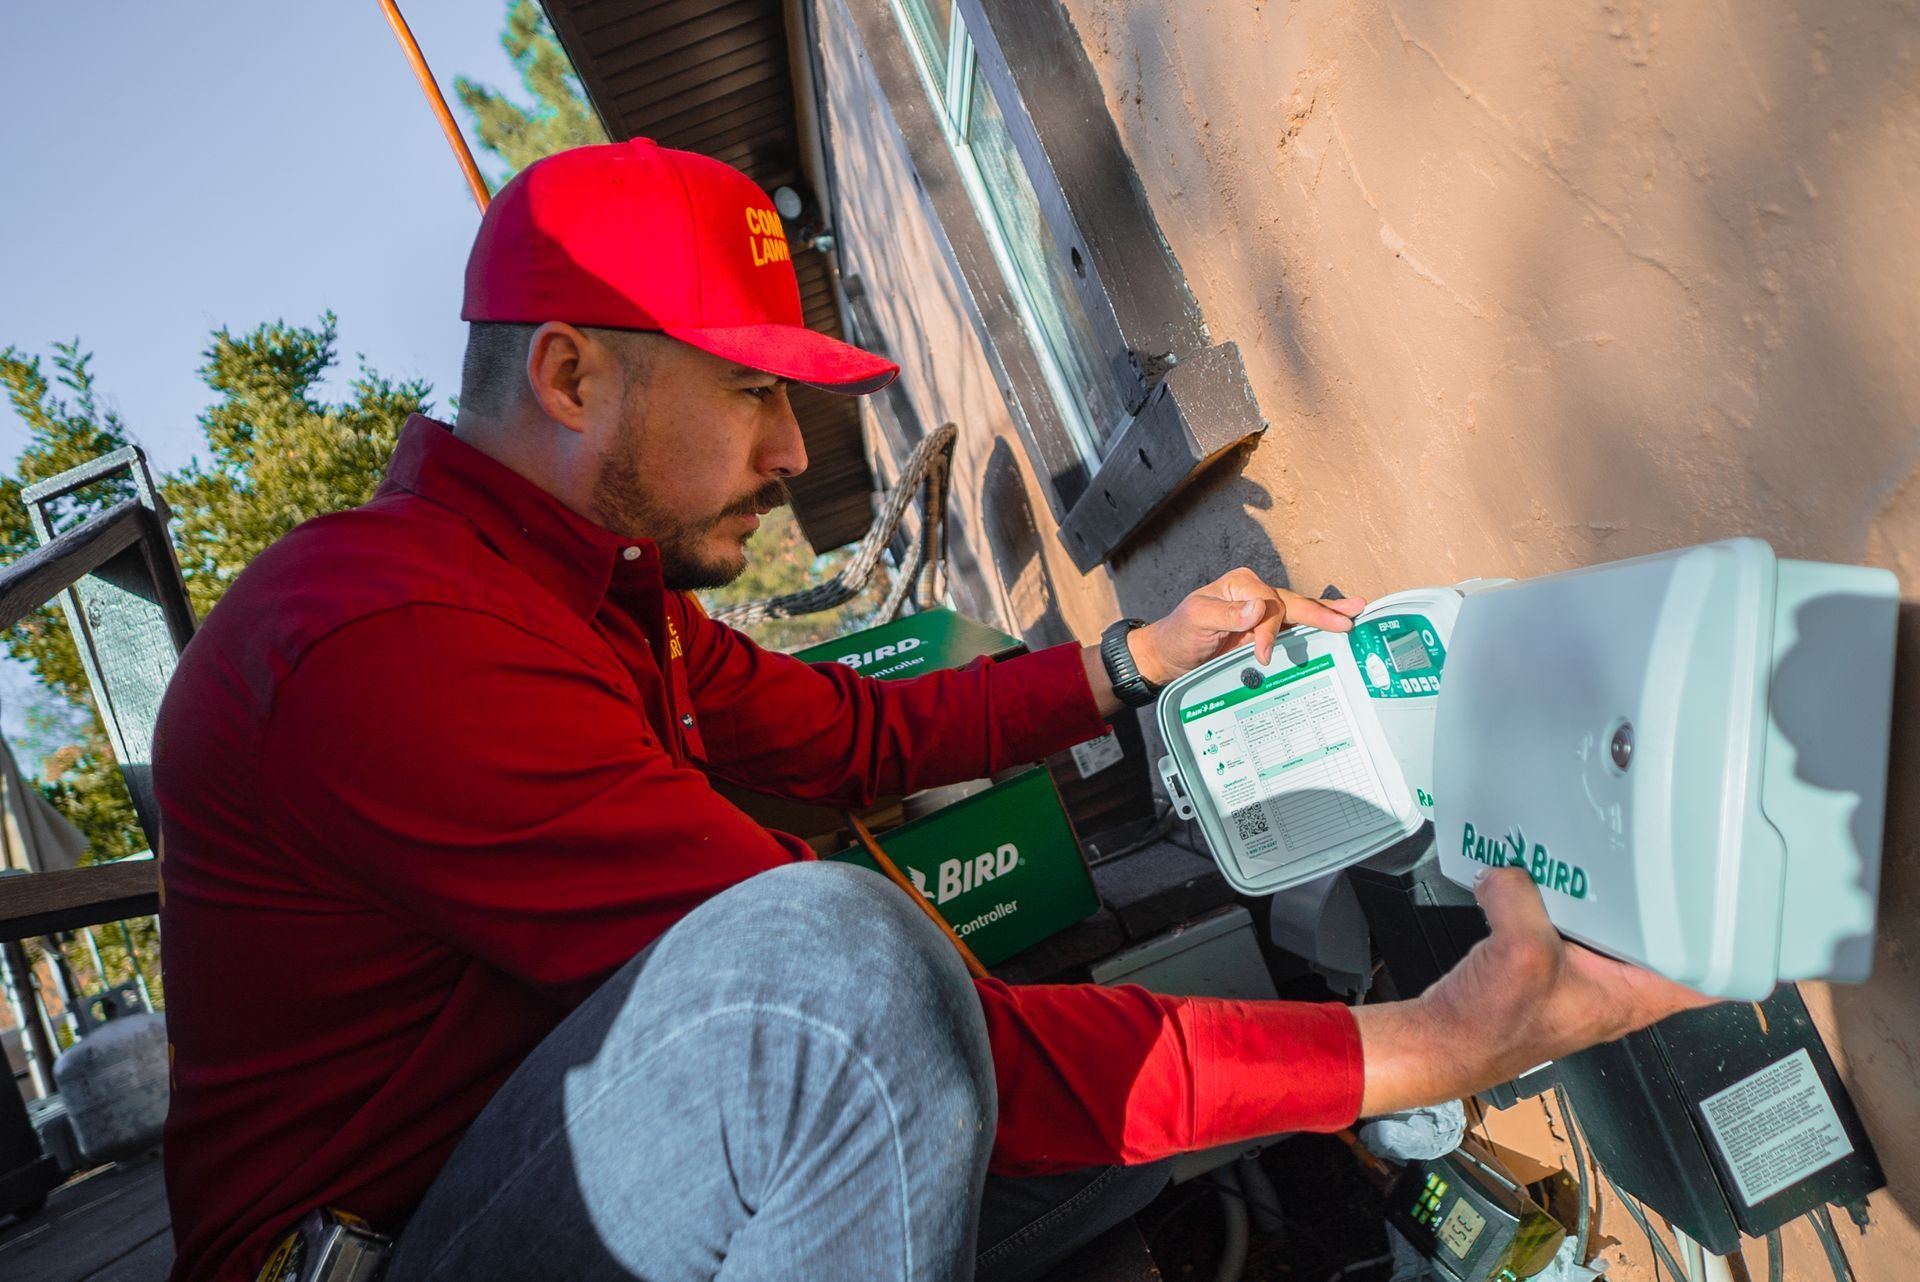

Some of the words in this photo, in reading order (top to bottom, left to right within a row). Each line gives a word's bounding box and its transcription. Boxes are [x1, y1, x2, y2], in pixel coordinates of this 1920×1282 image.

[838, 638, 921, 669] BIRD
[861, 656, 925, 679] ontroller
[1186, 710, 1203, 719] RAIN
[1209, 700, 1225, 710] BIRD
[937, 842, 1020, 906] BIRD
[1462, 822, 1507, 867] RAIN
[1531, 843, 1589, 900] BIRD
[952, 900, 1018, 939] Controller
